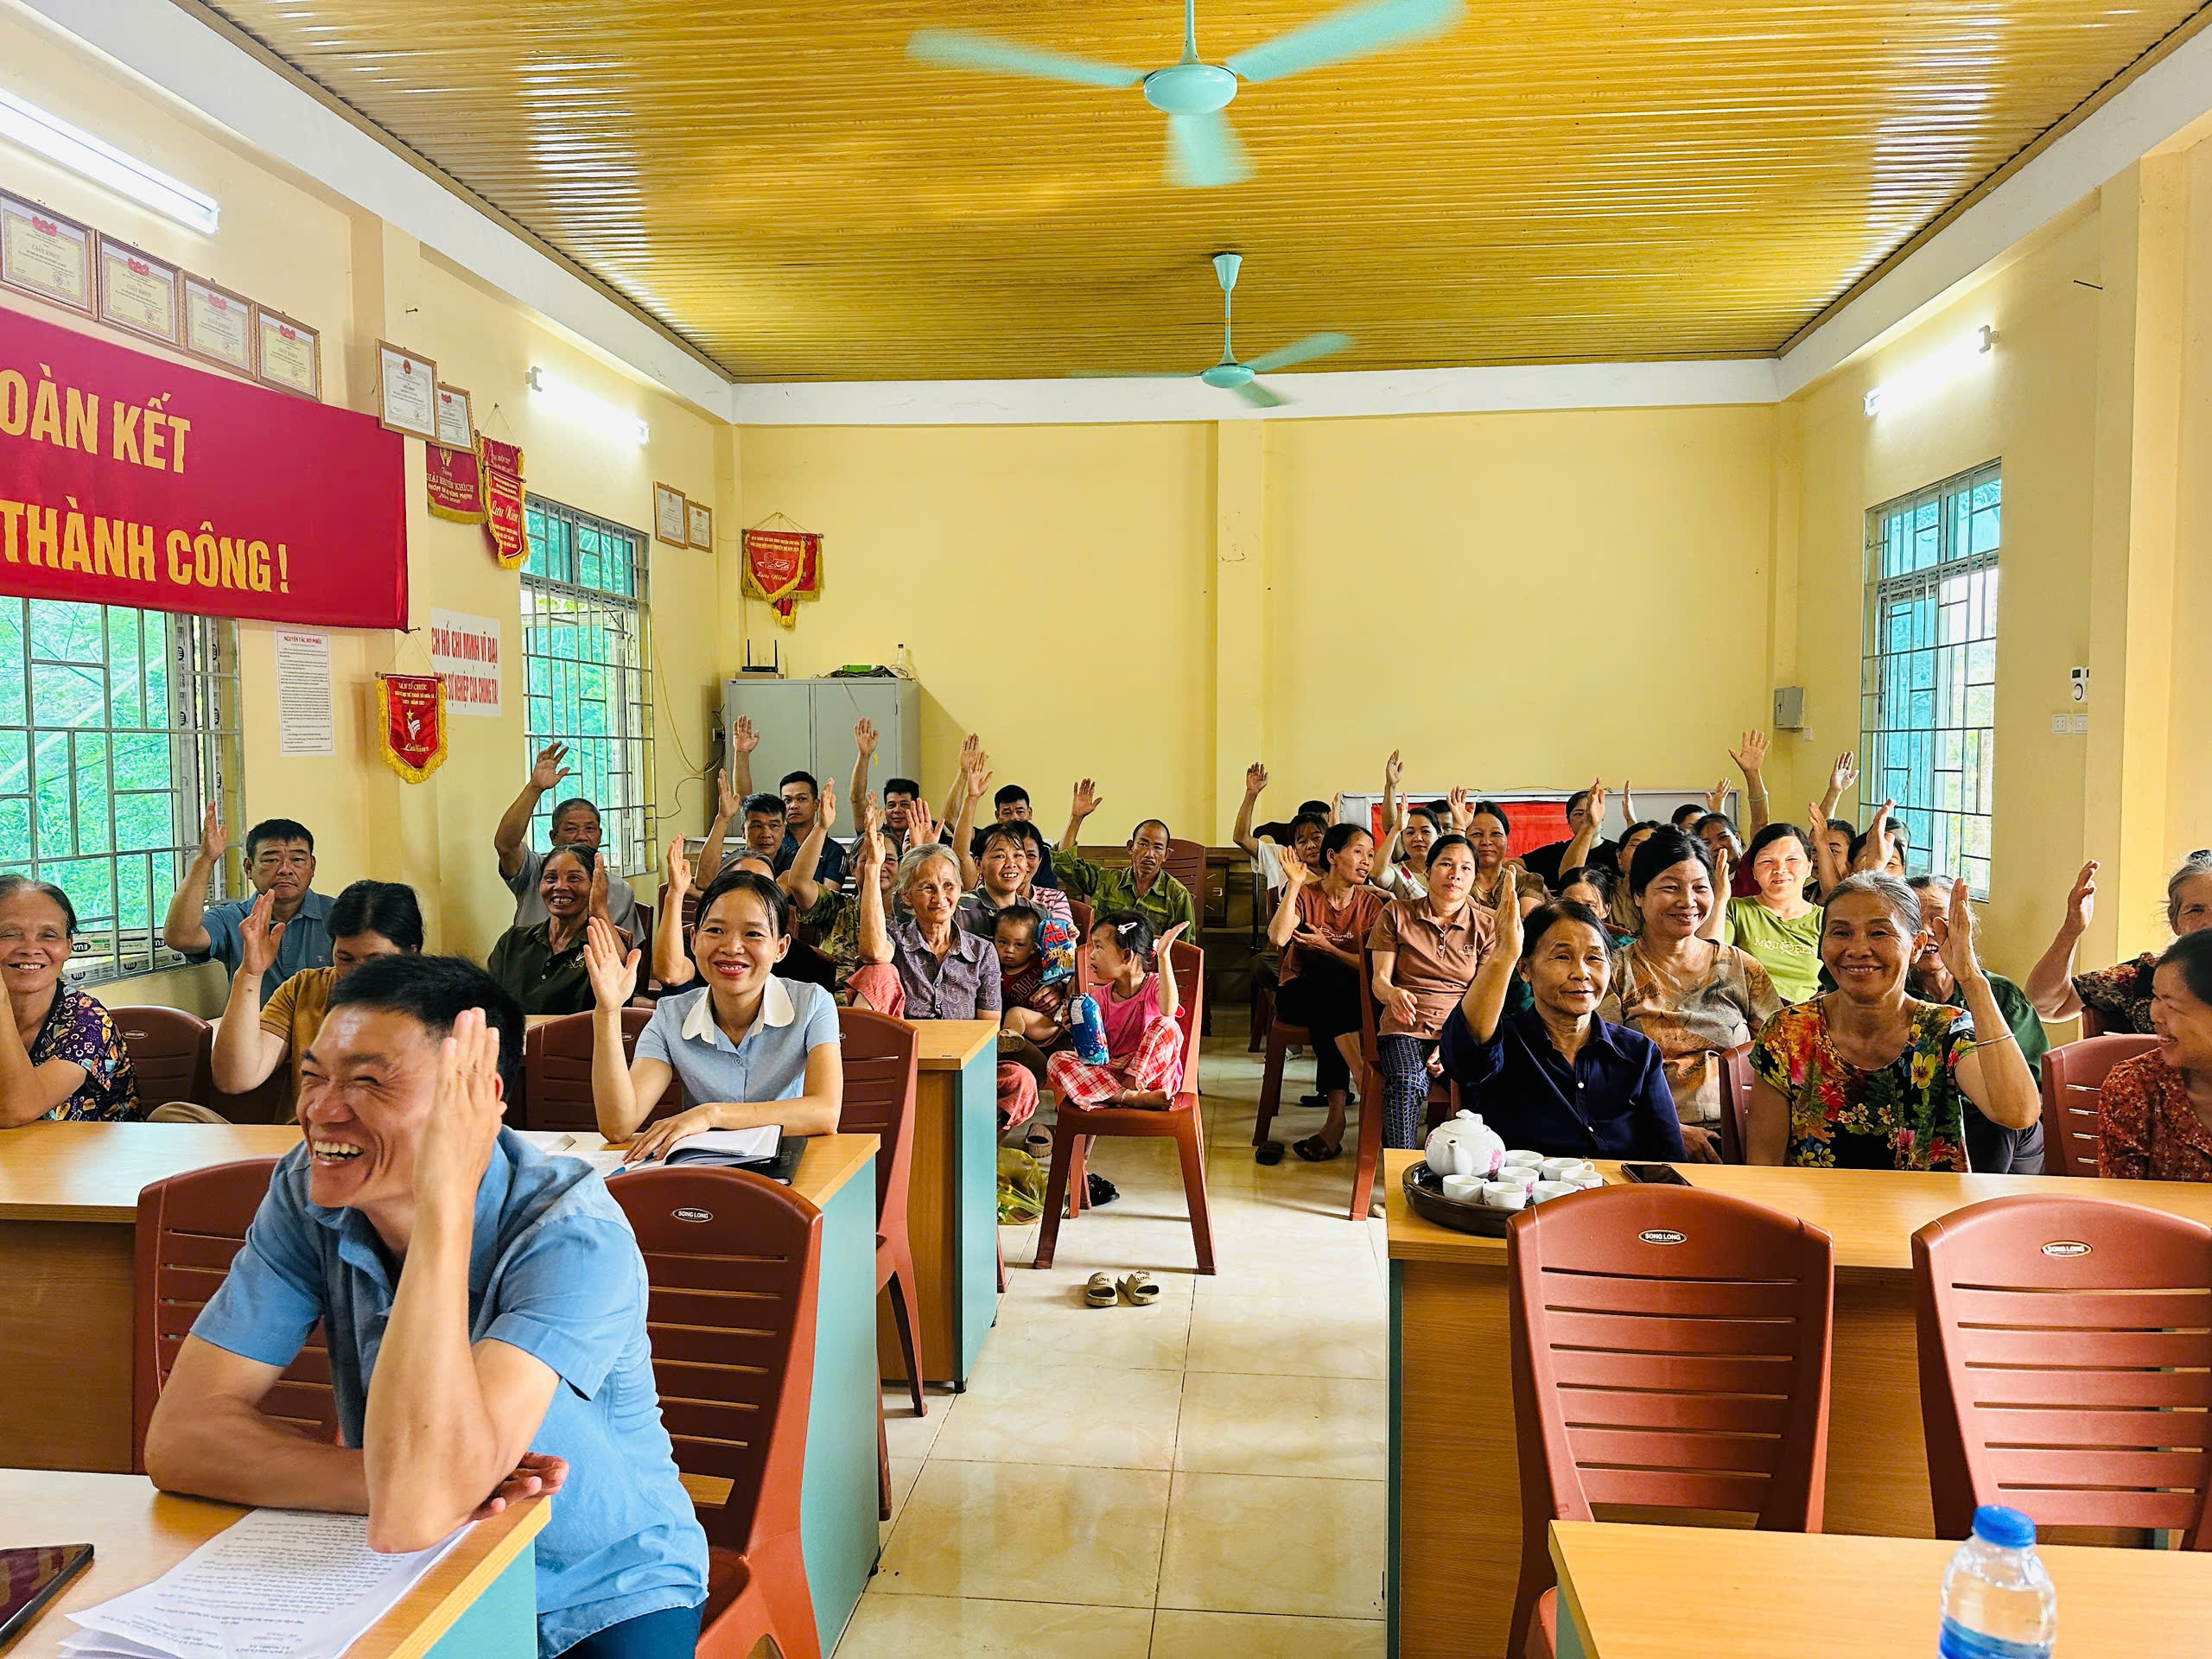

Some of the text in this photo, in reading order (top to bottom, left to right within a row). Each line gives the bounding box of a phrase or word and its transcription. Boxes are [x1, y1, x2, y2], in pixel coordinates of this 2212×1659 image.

[0, 363, 191, 474] OÀN KẾT
[0, 495, 156, 582] THÀNH
